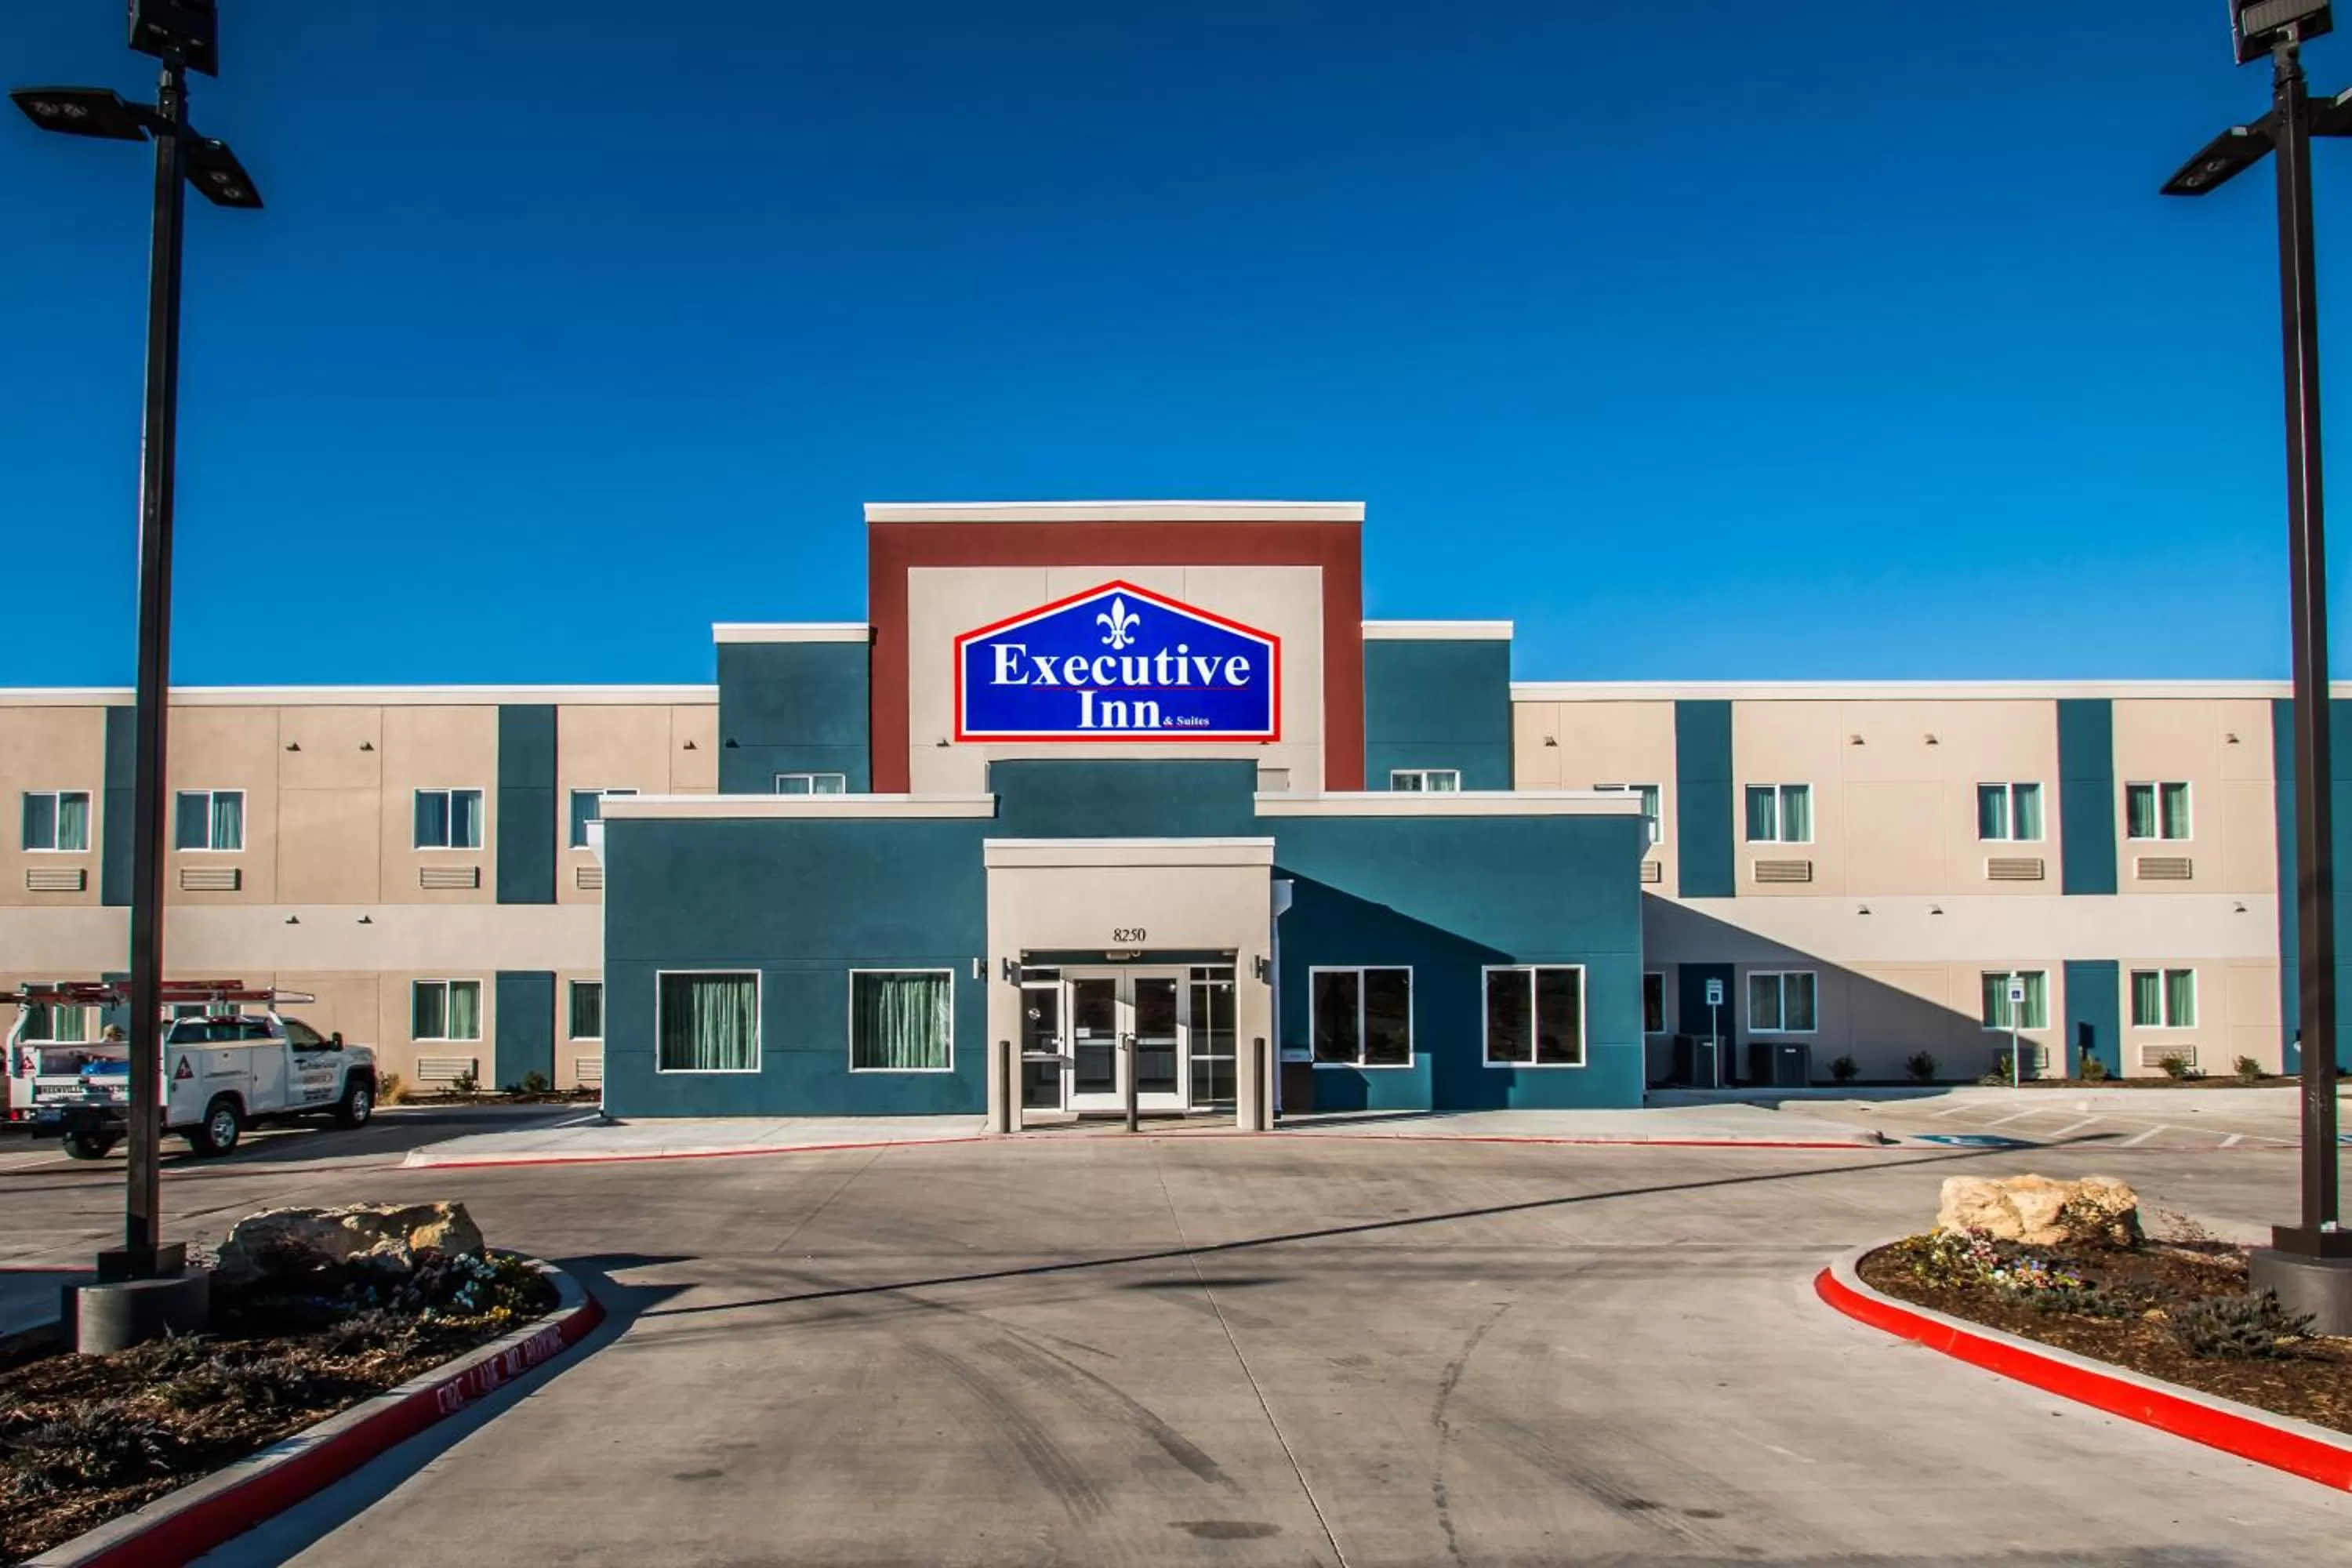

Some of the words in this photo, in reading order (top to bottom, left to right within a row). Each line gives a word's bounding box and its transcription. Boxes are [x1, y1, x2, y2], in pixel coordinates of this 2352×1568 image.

[990, 644, 1250, 685] Executive
[1077, 690, 1161, 728] Inn
[1163, 717, 1174, 726] &
[1177, 716, 1210, 726] Suites
[1114, 927, 1146, 942] 8250
